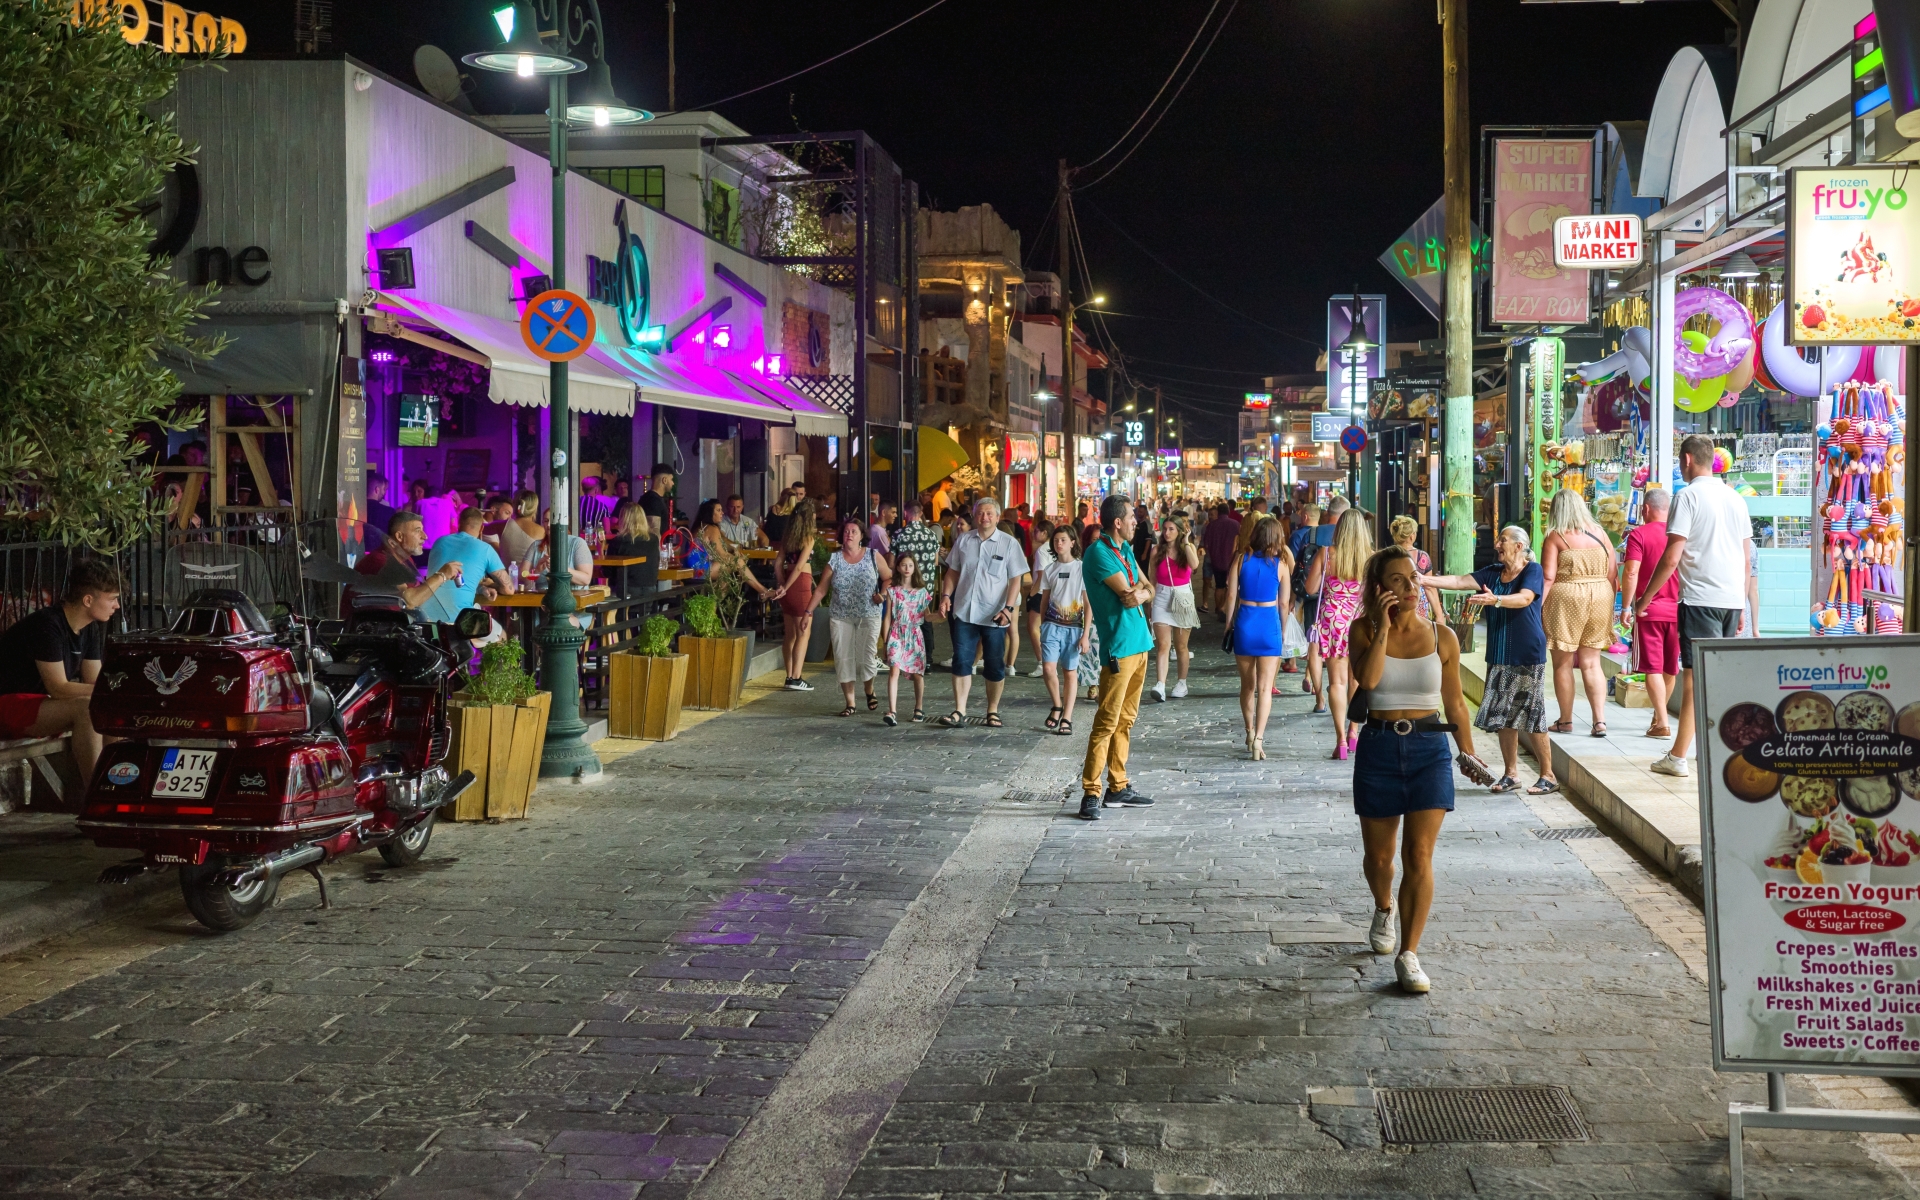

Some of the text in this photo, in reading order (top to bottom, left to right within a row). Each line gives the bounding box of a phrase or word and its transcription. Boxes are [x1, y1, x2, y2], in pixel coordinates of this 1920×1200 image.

[1509, 144, 1580, 165] SUPER
[1501, 173, 1587, 192] MARKET
[1830, 179, 1868, 188] frozen
[1812, 184, 1907, 219] fru.yo
[1570, 220, 1630, 239] MINI
[1563, 242, 1637, 259] MARKET
[1496, 296, 1584, 317] EAZY BOY
[344, 383, 363, 397] SHISHA
[1125, 422, 1142, 432] YO
[1126, 432, 1143, 442] LO
[346, 447, 356, 465] 15
[1777, 664, 1888, 689] frozen fru.yo
[1784, 731, 1889, 742] Homemade Ice Cream
[1760, 740, 1913, 761] Gelato Artigianale
[174, 754, 213, 771] ATK
[168, 776, 207, 792] 925
[1765, 882, 1840, 900] Frozen
[1797, 908, 1891, 919] Gluten, Lactose
[1805, 919, 1884, 931] & Sugar free
[1776, 940, 1835, 959] Crepes
[1853, 941, 1918, 958] Waffles
[1801, 959, 1894, 976] Smoothies
[1757, 976, 1855, 993] Milkshakes
[1766, 995, 1814, 1011] Fresh
[1819, 997, 1872, 1012] Mixed
[1797, 1015, 1904, 1032] Fruit Salads
[1783, 1033, 1920, 1051] Sweets Coffee
